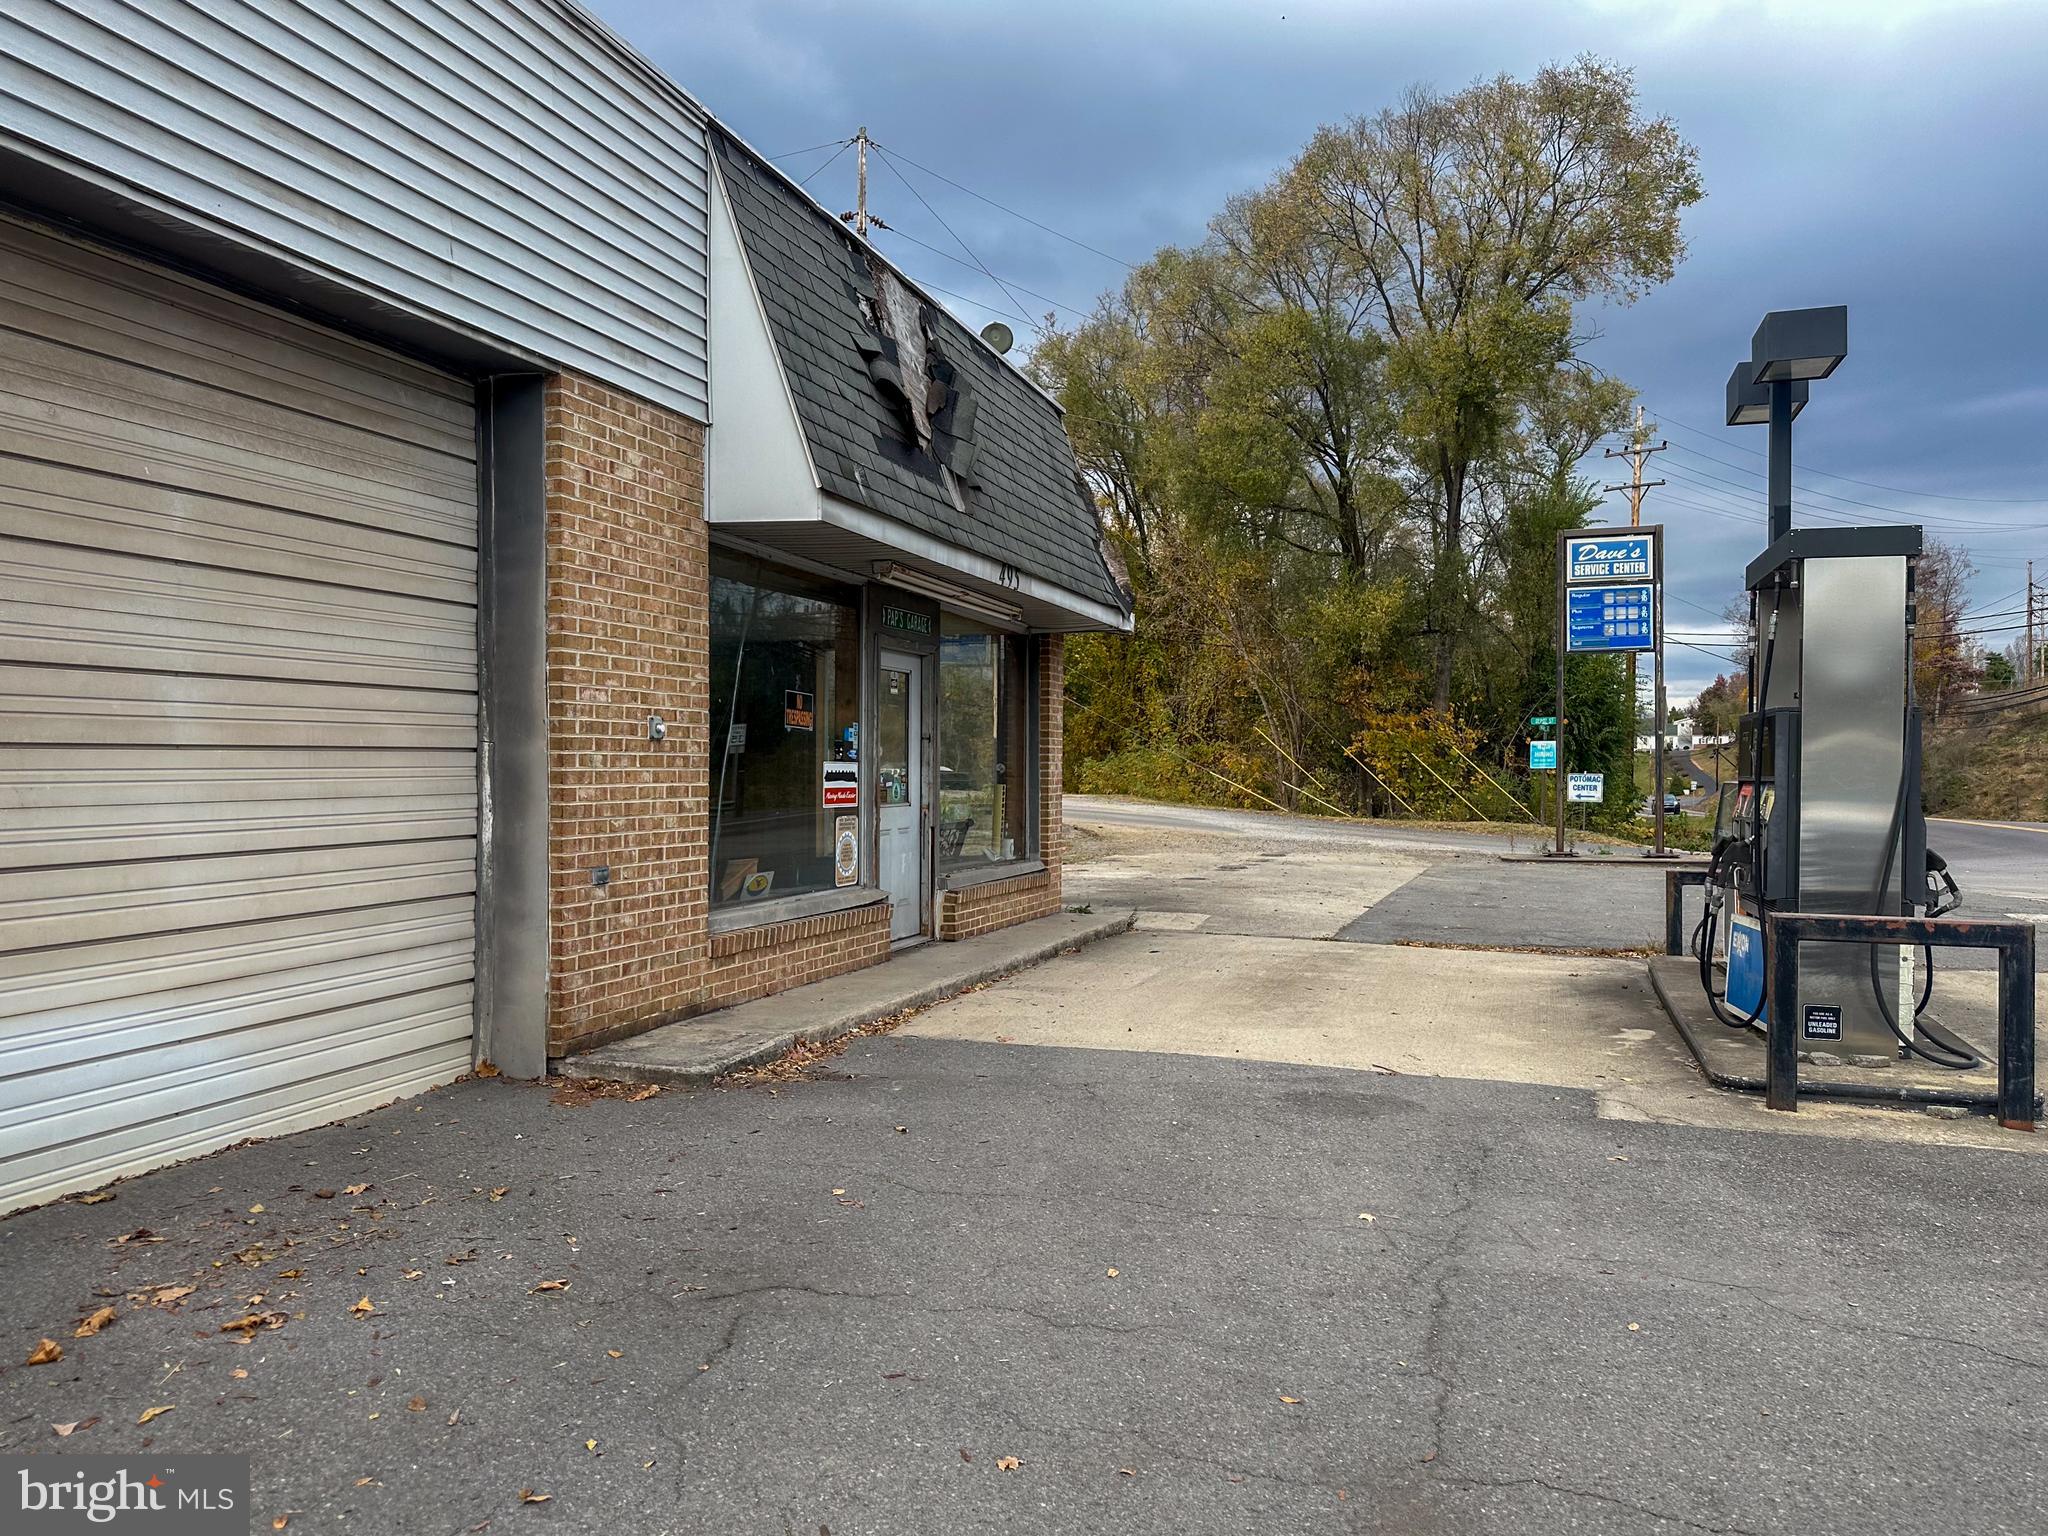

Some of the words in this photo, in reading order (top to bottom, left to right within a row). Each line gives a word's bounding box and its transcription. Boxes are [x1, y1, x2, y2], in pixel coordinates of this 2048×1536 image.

[1579, 542, 1642, 560] Dave's
[1574, 563, 1609, 576] SERVICE
[1613, 562, 1646, 574] CENTER
[1573, 784, 1598, 792] CENTER
[1807, 1021, 1838, 1029] UNLEADED
